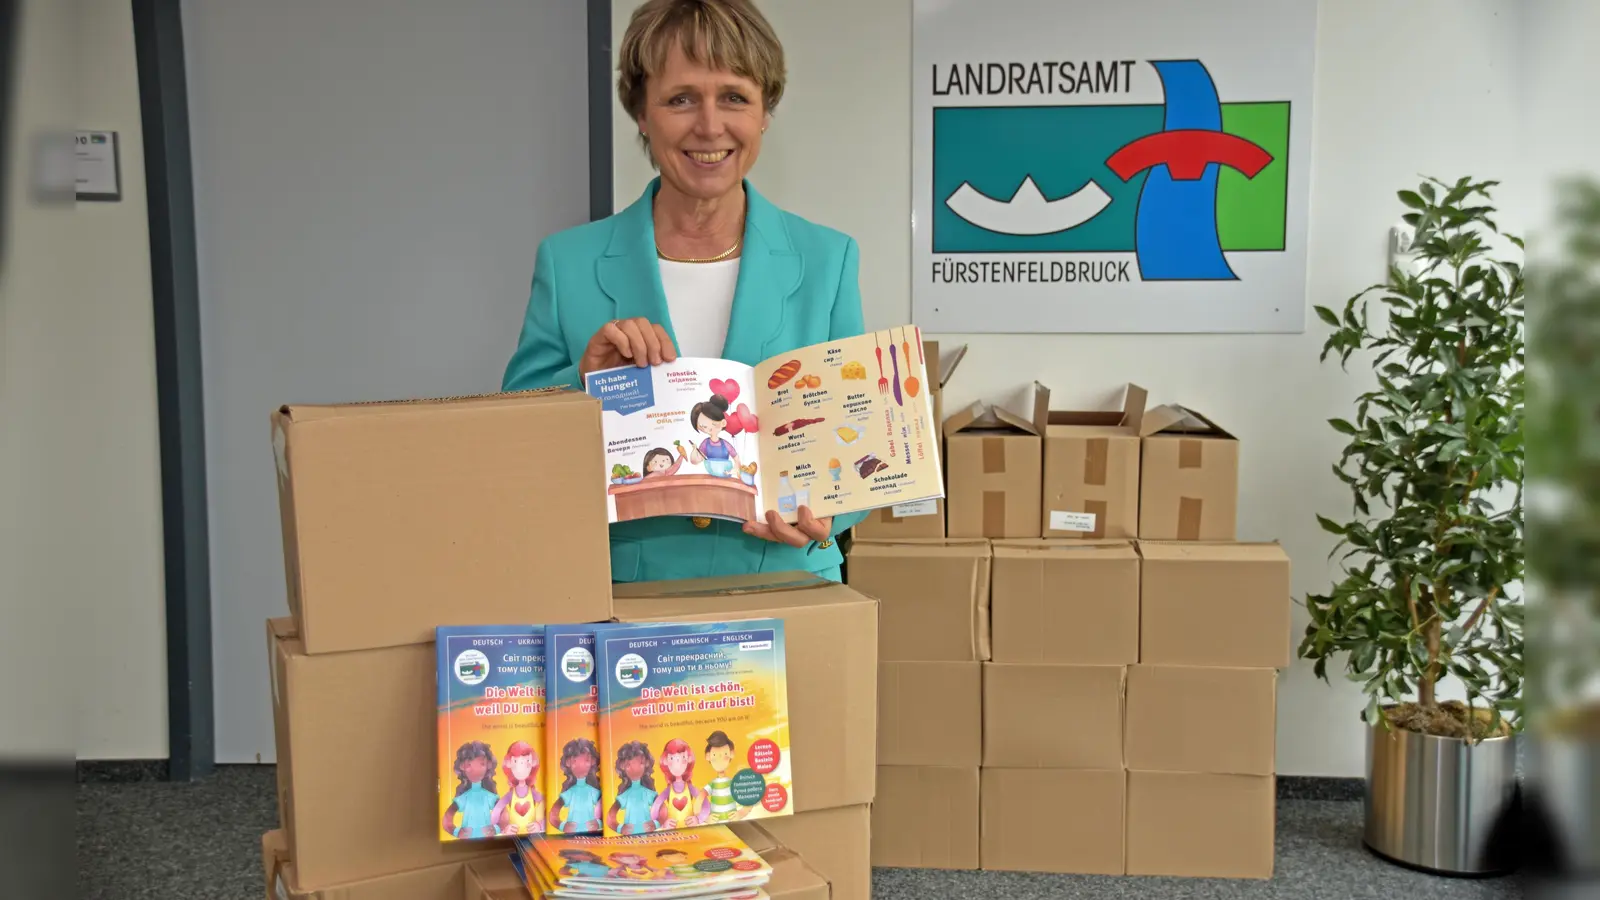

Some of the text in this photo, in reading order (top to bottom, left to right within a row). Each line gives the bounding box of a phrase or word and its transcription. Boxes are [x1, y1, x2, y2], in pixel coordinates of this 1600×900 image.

[932, 60, 1136, 95] LANDRATSAMT
[932, 258, 1130, 283] FÜRSTENFELDBRUCK
[607, 375, 627, 383] habe
[666, 370, 697, 378] Frühstück
[600, 379, 639, 393] Hunger!
[802, 390, 828, 399] Brötchen
[847, 393, 866, 401] Butter
[646, 411, 686, 419] Mittagessen
[849, 406, 868, 414] масло
[608, 435, 647, 447] Abendessen
[788, 433, 805, 441] Wurst
[888, 440, 896, 457] Gabel
[904, 442, 912, 464] Messer
[795, 463, 812, 471] Milch
[793, 471, 816, 479] молоко
[873, 472, 908, 483] Schokolade
[869, 483, 897, 491] шоколад
[671, 636, 709, 646] UKRAINISCH
[722, 634, 753, 642] ENGLISCH
[503, 654, 520, 662] Світ
[657, 653, 675, 663] Світ
[497, 666, 518, 674] тому
[519, 665, 532, 673] що
[652, 665, 672, 675] тому
[673, 664, 686, 673] що
[687, 663, 697, 671] ти
[704, 660, 733, 671] ньому!
[485, 686, 505, 698] Die
[507, 685, 534, 697] Welt
[642, 681, 744, 699] Die Welt ist schön,
[474, 702, 541, 715] weil DU mit
[632, 695, 755, 716] weil DU mit drauf bist!
